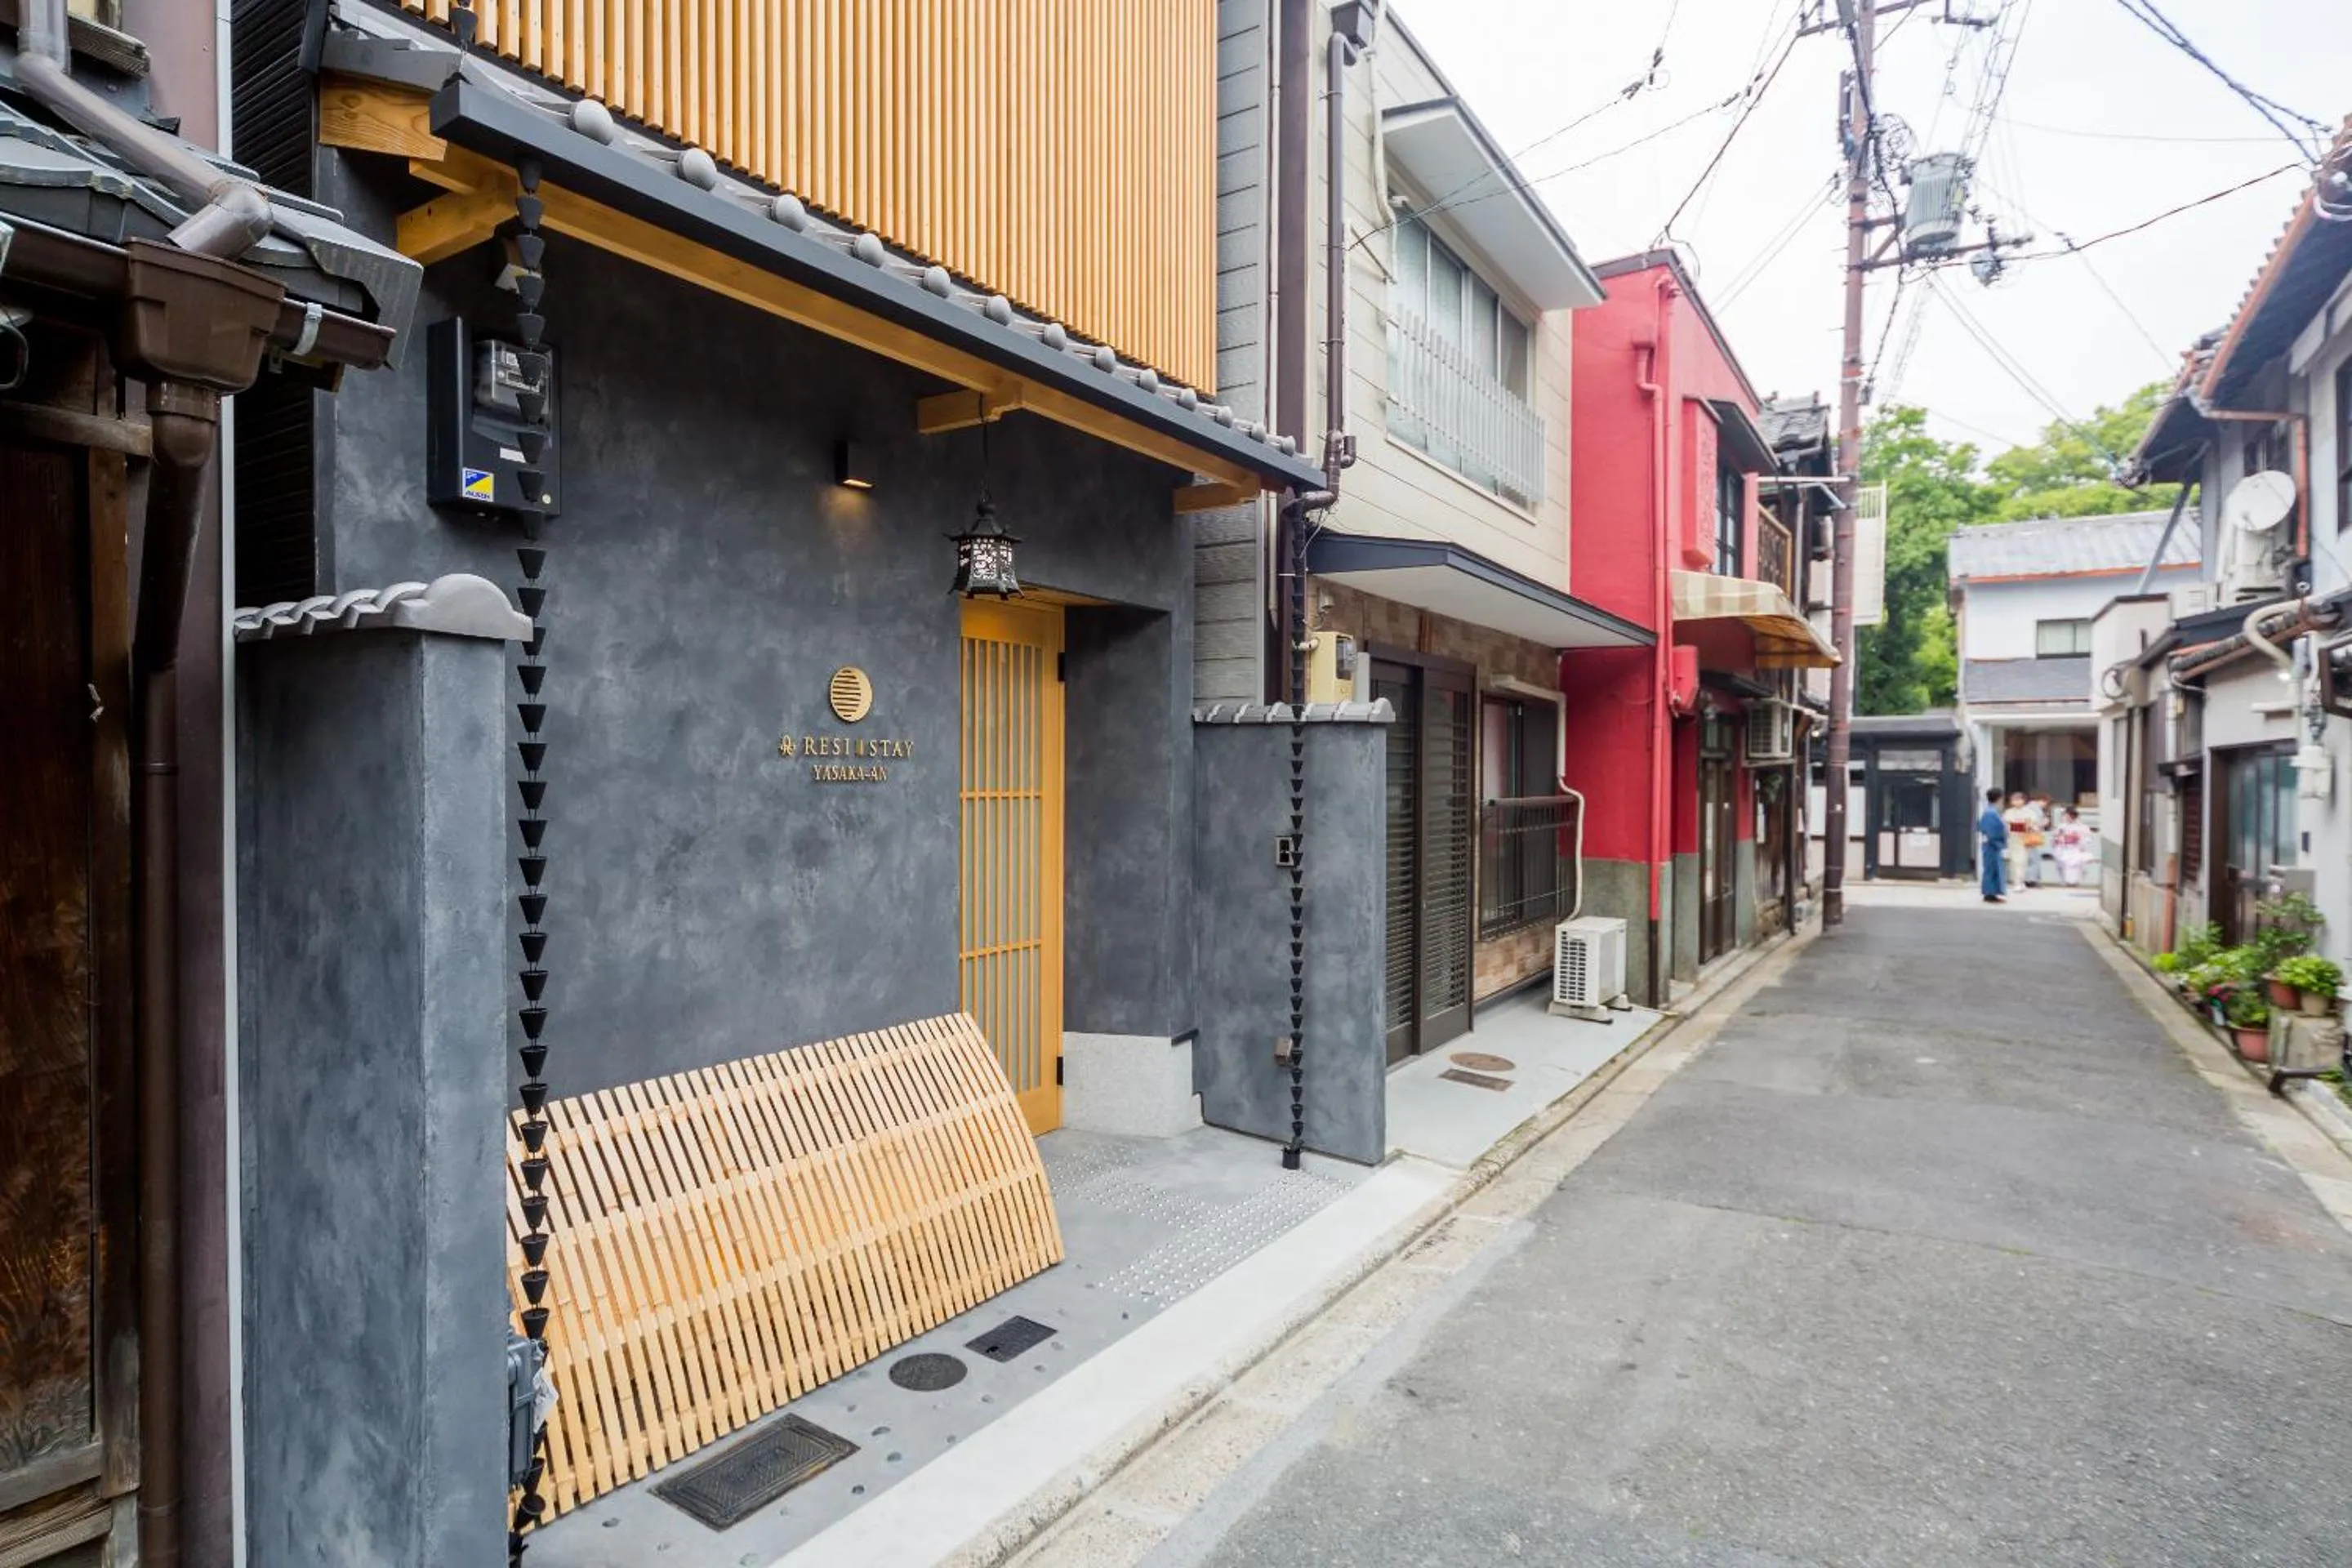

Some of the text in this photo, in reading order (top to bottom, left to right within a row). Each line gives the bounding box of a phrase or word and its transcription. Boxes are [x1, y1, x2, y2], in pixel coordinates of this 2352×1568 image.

[803, 737, 915, 758] RESI STAY
[813, 764, 888, 782] YASAKA-AN
